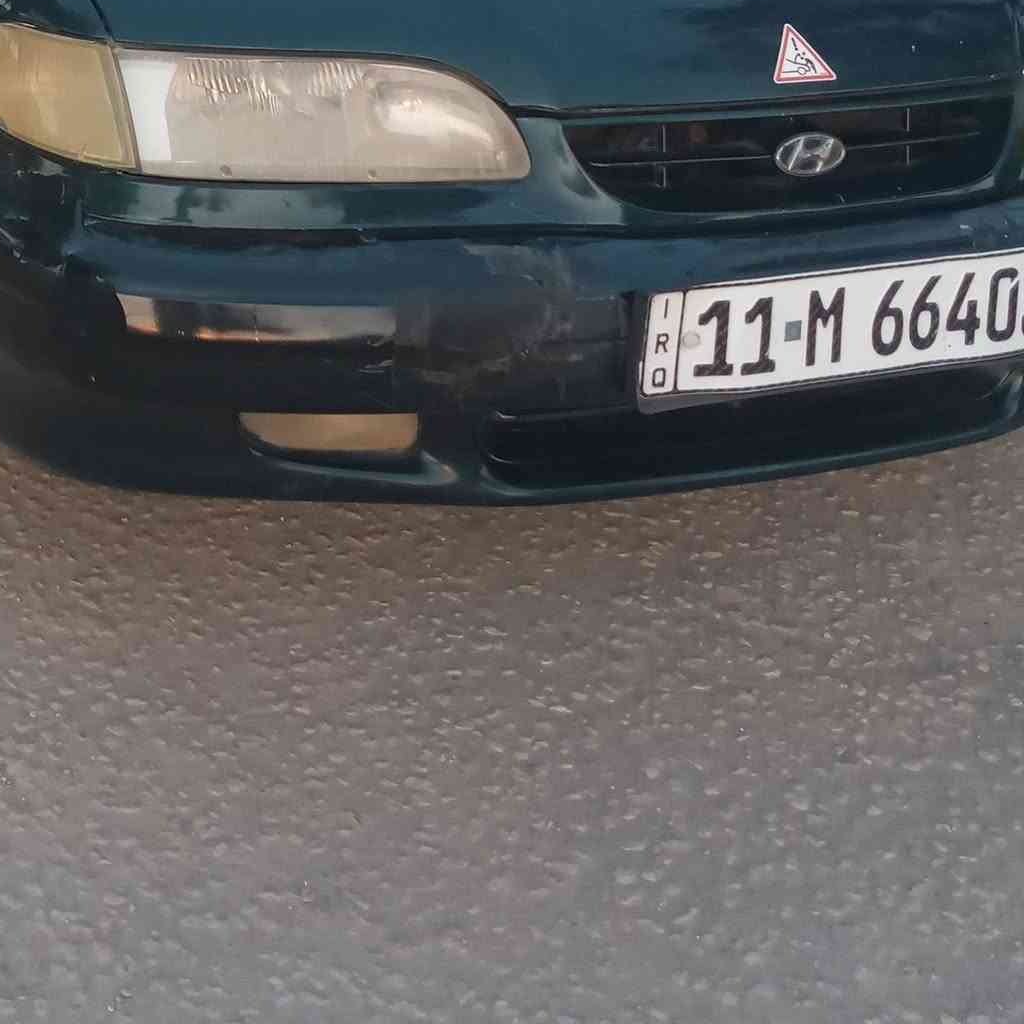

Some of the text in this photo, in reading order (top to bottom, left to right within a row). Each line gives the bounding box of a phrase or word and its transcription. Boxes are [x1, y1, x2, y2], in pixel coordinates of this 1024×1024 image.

[651, 297, 670, 388] IRQ
[693, 267, 1024, 377] 11 M 6640
